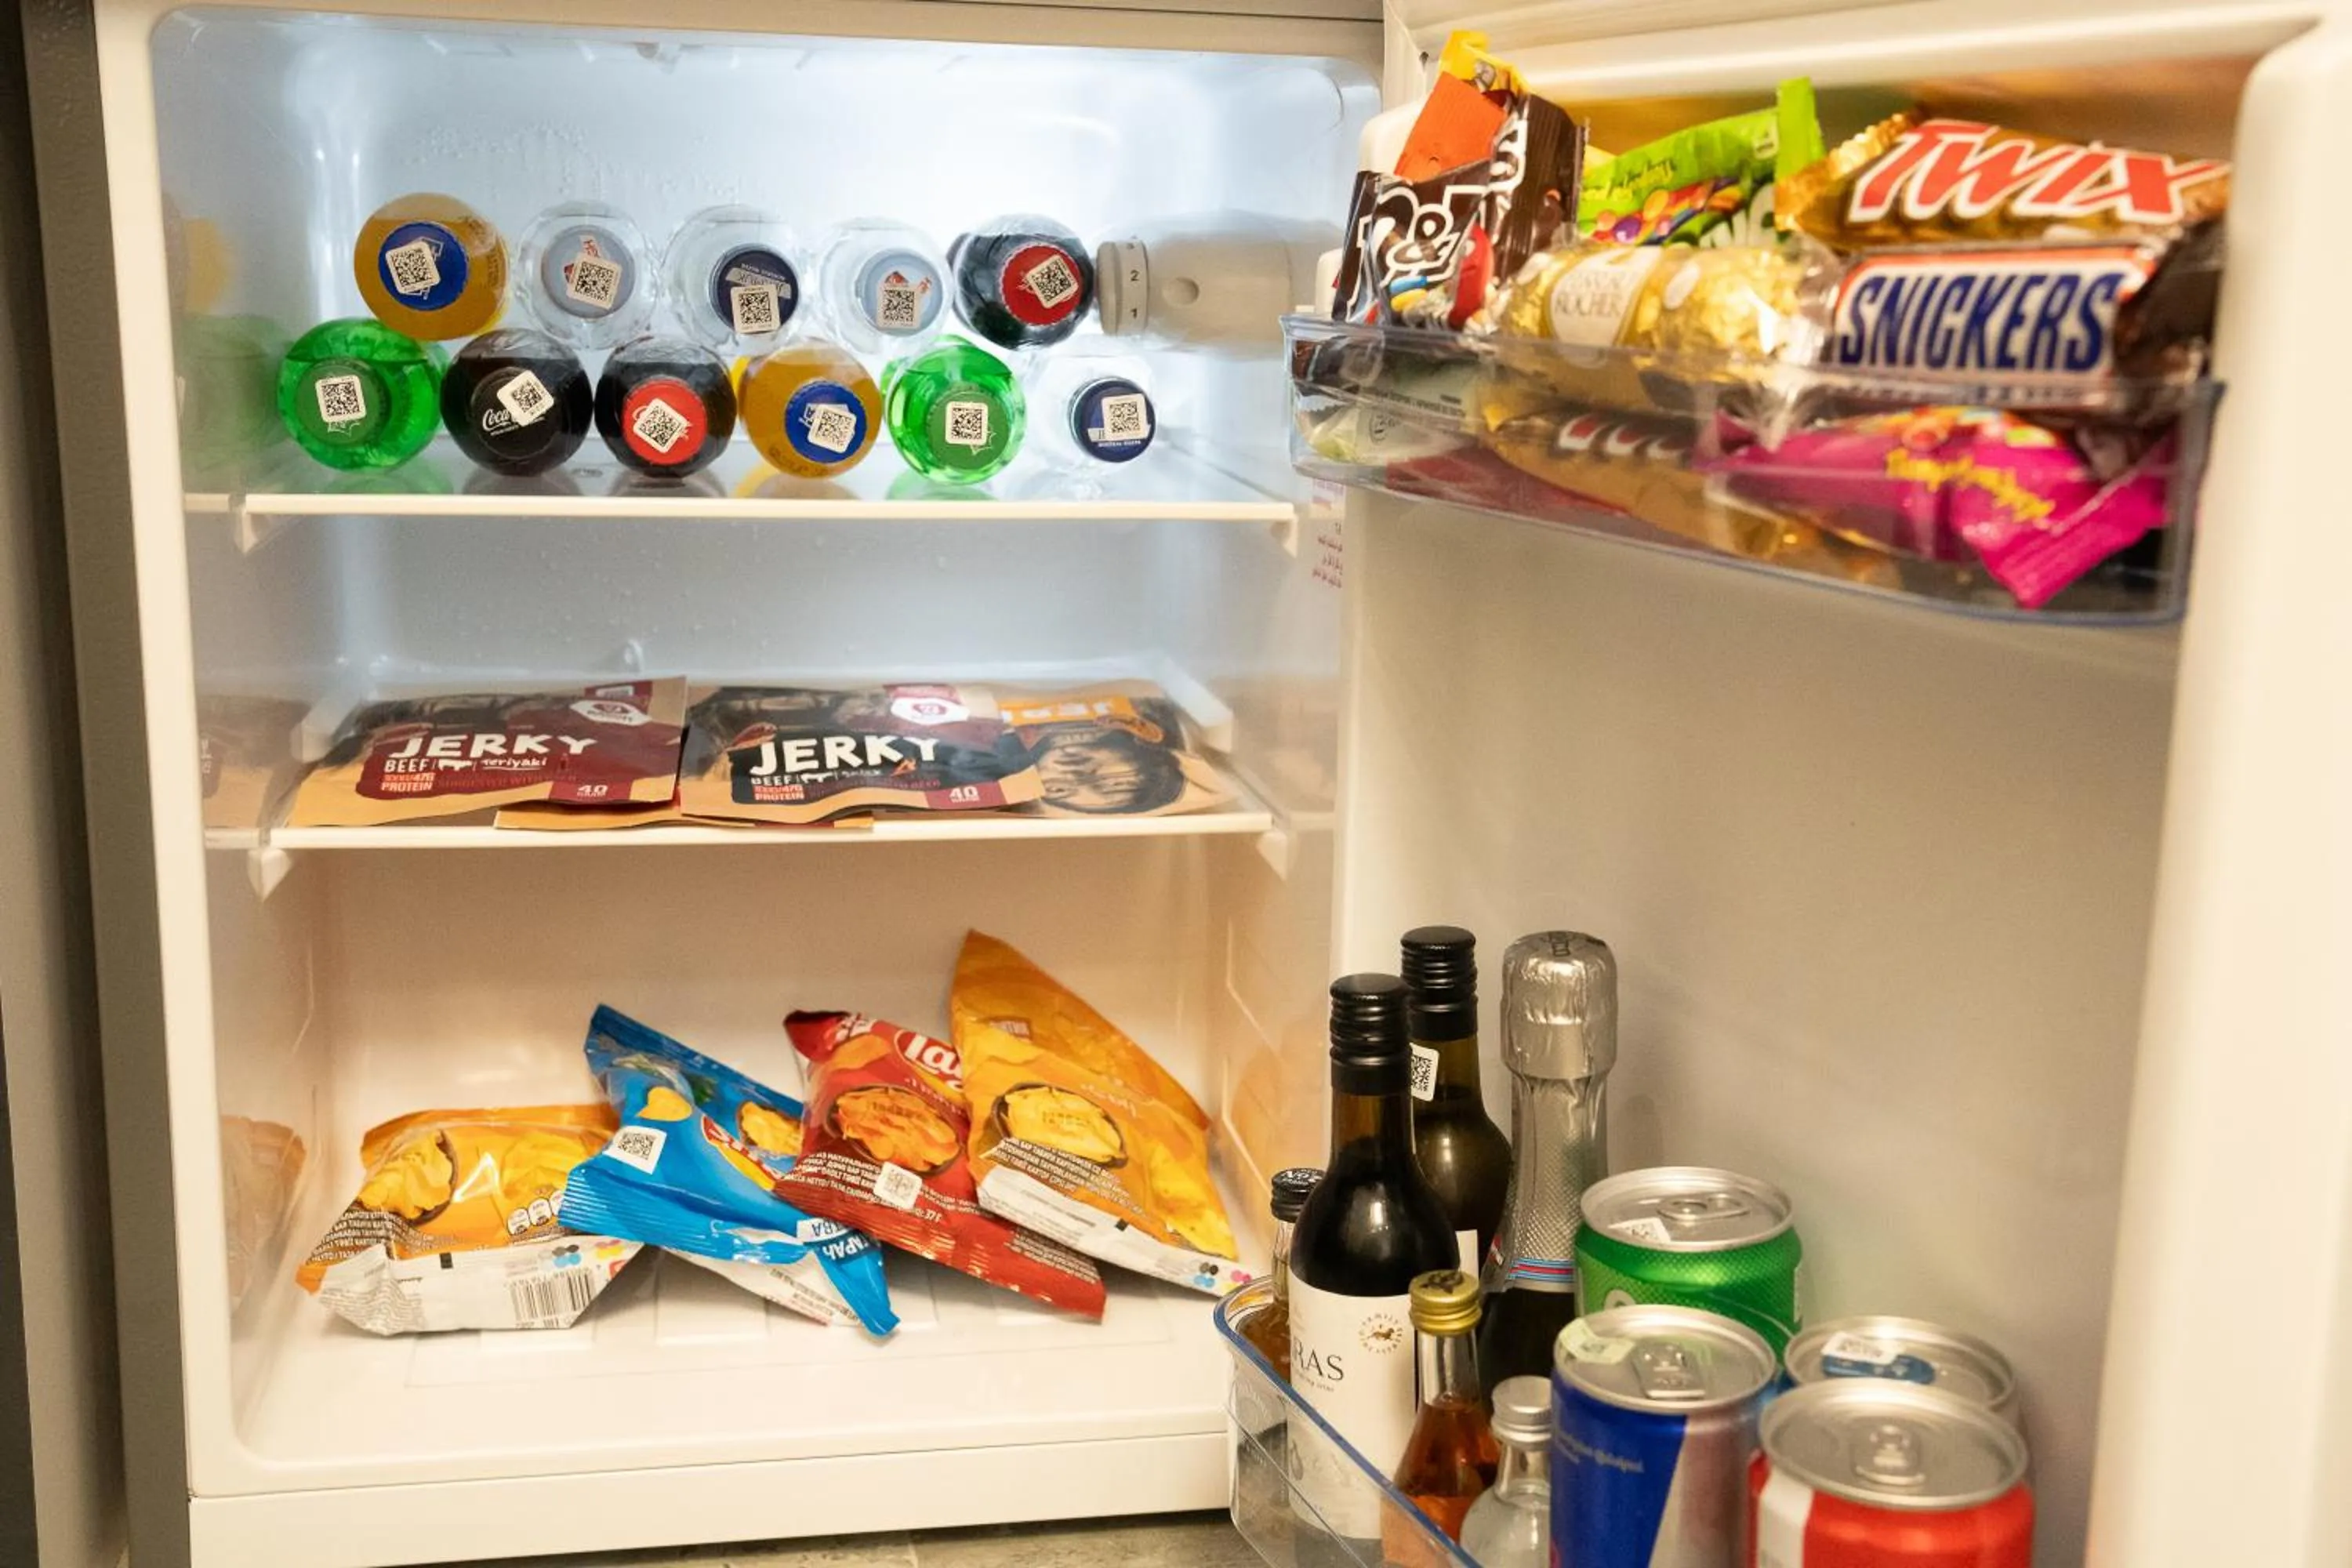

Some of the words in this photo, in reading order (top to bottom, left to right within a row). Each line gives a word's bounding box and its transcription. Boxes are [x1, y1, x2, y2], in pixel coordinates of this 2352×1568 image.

[1131, 269, 1140, 281] 2
[1130, 307, 1138, 319] 1
[1839, 271, 2127, 372] SNICKERS
[388, 734, 598, 759] JERKY
[750, 735, 940, 776] JERKY
[384, 758, 430, 773] BEEF
[381, 782, 434, 792] PROTEIN
[578, 785, 608, 793] 40
[949, 786, 979, 798] 40
